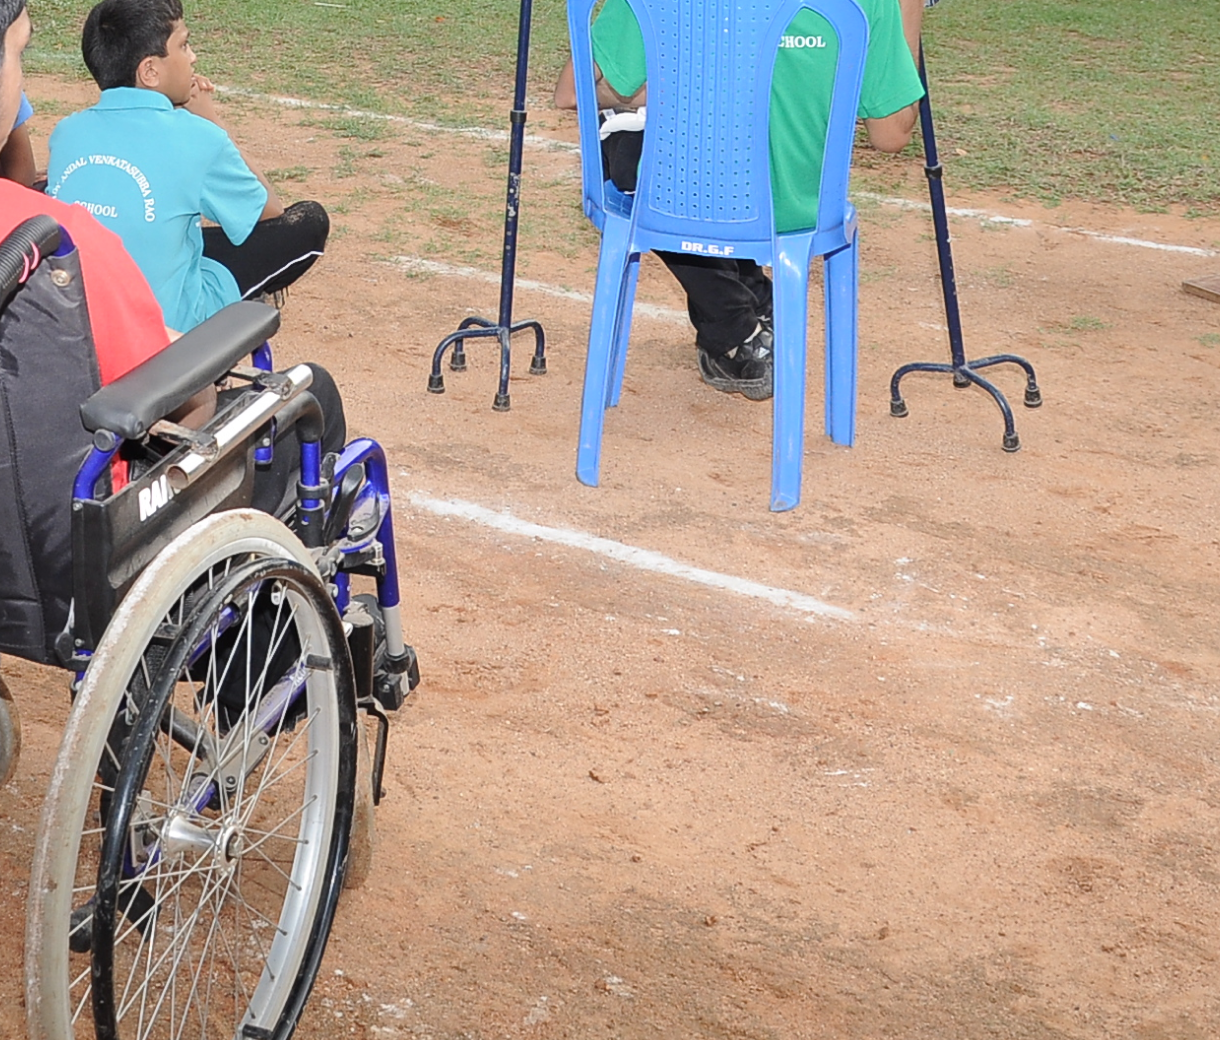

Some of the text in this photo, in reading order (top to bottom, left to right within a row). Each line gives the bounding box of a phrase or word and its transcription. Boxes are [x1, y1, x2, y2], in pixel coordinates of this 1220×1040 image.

[777, 35, 827, 48] CHOOL
[88, 154, 152, 198] VENKATASUBBA
[144, 197, 156, 223] RAO
